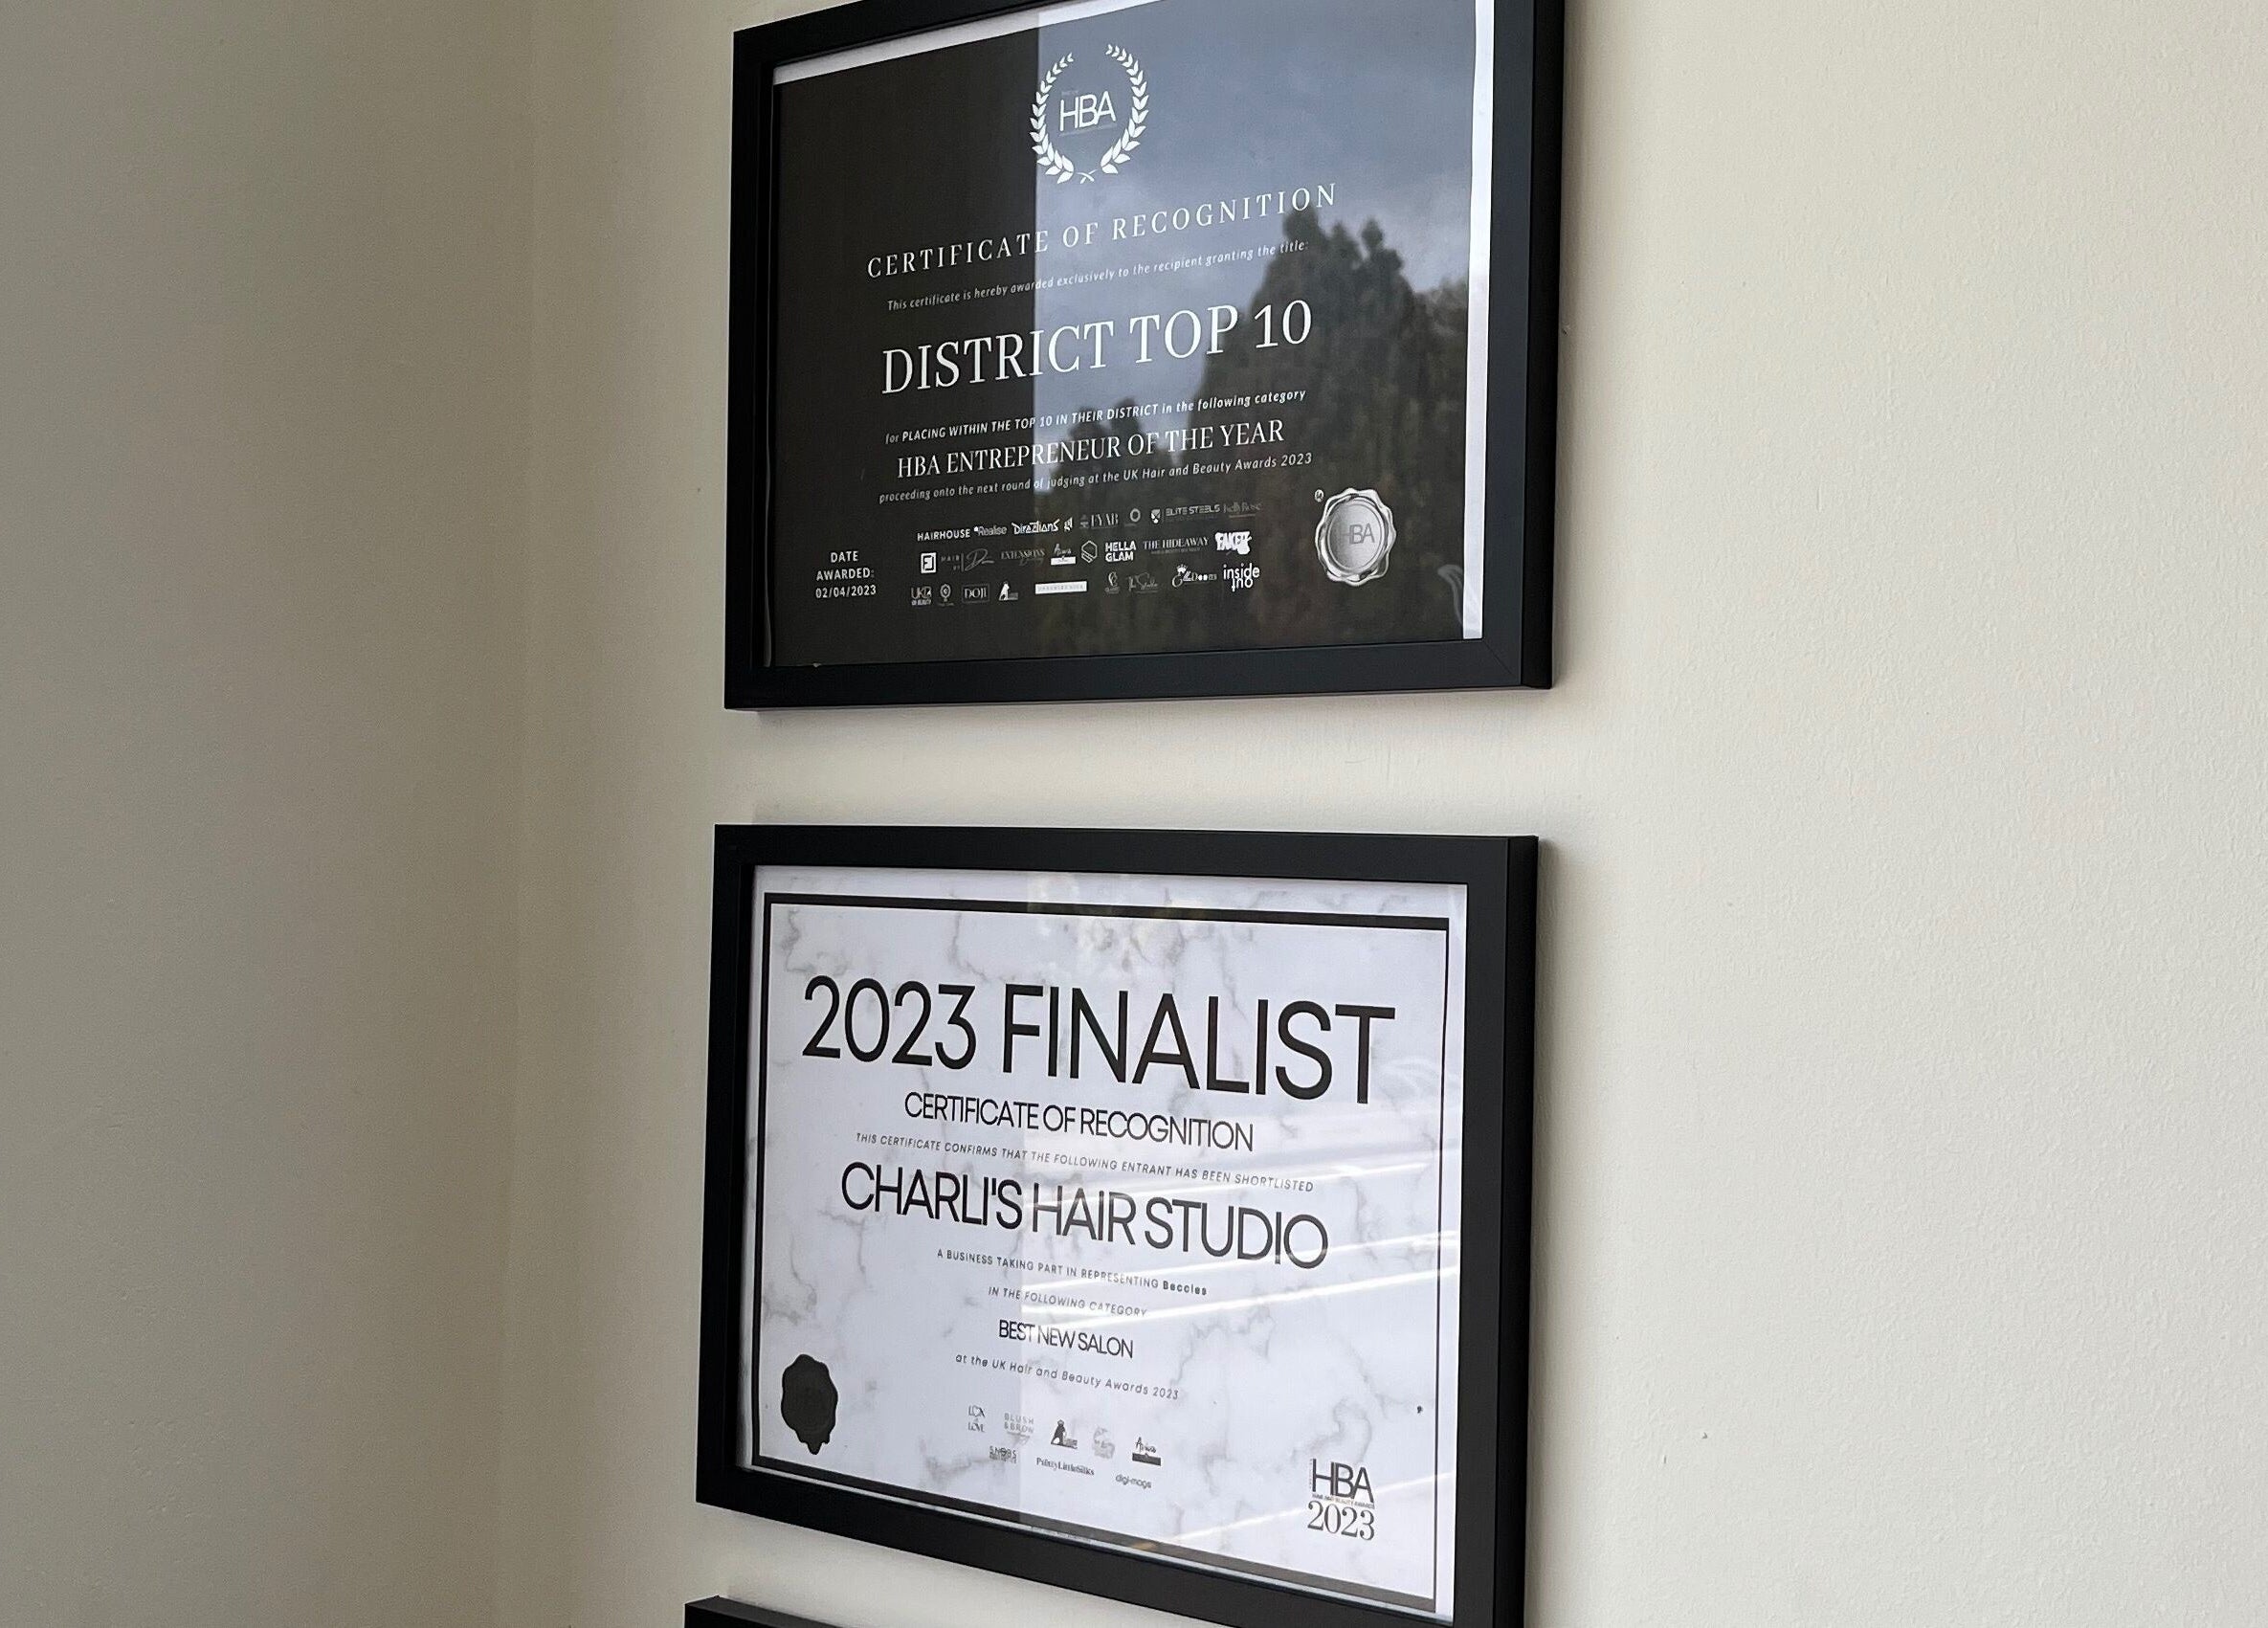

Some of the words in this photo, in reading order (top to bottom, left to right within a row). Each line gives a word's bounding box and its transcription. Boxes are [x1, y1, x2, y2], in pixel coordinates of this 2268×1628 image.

[1059, 90, 1117, 132] HBA
[867, 230, 1049, 279] CERTIFICATE
[1062, 222, 1100, 248] OF
[1111, 183, 1336, 240] RECOGNITION
[887, 300, 907, 311] This
[909, 291, 961, 308] certificate
[963, 288, 972, 301] is
[974, 284, 1009, 300] hereby
[1010, 277, 1055, 294] awarded
[1056, 266, 1116, 286] exclusively
[1118, 267, 1130, 278] to
[1133, 263, 1151, 275] the
[1153, 256, 1203, 274] recipient
[1205, 249, 1254, 267] granting
[1257, 245, 1277, 256] the
[881, 321, 1114, 394] DISTRICT
[1129, 304, 1239, 364] TOP
[1254, 300, 1312, 349] 10
[885, 433, 900, 445] for
[901, 427, 946, 442] PLACING
[948, 422, 988, 437] WITHIN
[990, 419, 1012, 433] THE
[1014, 416, 1036, 430] TOP
[1039, 415, 1053, 428] 10
[1056, 413, 1068, 425] IN
[1072, 410, 1104, 424] THEIR
[1106, 403, 1159, 421] DISTRICT
[1162, 402, 1173, 414] in
[1176, 399, 1195, 413] the
[1197, 393, 1252, 412] following
[1254, 390, 1306, 405] category
[897, 455, 941, 479] HBA
[945, 436, 1122, 475] ENTREPRENEUR
[1127, 432, 1160, 457] OF
[1165, 426, 1214, 453] THE
[1218, 419, 1285, 447] YEAR
[878, 485, 931, 504] proceeding
[933, 486, 956, 498] onto
[958, 483, 974, 496] the
[976, 482, 999, 494] next
[1001, 478, 1032, 492] round
[1045, 474, 1085, 491] judging
[1088, 473, 1100, 484] at
[1102, 470, 1121, 482] the
[1123, 469, 1139, 481] UK
[1142, 466, 1166, 479] Hair
[1168, 463, 1190, 477] and
[1192, 461, 1233, 476] Beauty
[1234, 456, 1278, 472] Awards
[1280, 452, 1313, 467] 2023
[830, 550, 859, 564] DATE
[917, 528, 971, 542] HAIRHOUSE
[1104, 540, 1137, 552] HELLA
[1104, 550, 1135, 563] GLAM
[815, 568, 875, 582] AWARDED:
[815, 584, 877, 599] 02/04/2023
[1223, 562, 1260, 580] inside
[802, 975, 978, 1070] 2023
[1003, 983, 1396, 1104] FINALIST
[904, 1091, 1039, 1130] CERTIFICATE
[1042, 1104, 1078, 1133] OF
[1079, 1108, 1254, 1152] RECOGNITION
[856, 1132, 878, 1145] THIS
[879, 1135, 941, 1151] CERTIFICATE
[944, 1142, 998, 1157] CONFIRMS
[1002, 1148, 1028, 1161] THAT
[1031, 1150, 1051, 1163] THE
[1054, 1153, 1118, 1171] FOLLOWING
[1121, 1161, 1172, 1177] ENTRANT
[1175, 1168, 1198, 1179] HAS
[1202, 1170, 1232, 1184] BEEN
[1234, 1173, 1315, 1193] SHORTLISTED
[841, 1161, 1024, 1230] CHARLI'S
[1032, 1182, 1136, 1246] HAIR
[1144, 1196, 1329, 1270] STUDIO
[937, 1248, 945, 1259] A
[946, 1249, 993, 1265] BUSINESS
[997, 1256, 1034, 1272] TAKING
[1037, 1261, 1064, 1276] PART
[1066, 1266, 1078, 1278] IN
[1080, 1268, 1160, 1289] REPRESENTING
[1162, 1280, 1208, 1296] Beccles
[988, 1286, 999, 1297] IN
[1003, 1287, 1022, 1300] THE
[1024, 1291, 1086, 1309] FOLLOWING
[1089, 1301, 1148, 1318] CATEGORY
[999, 1319, 1035, 1341] BEST
[1037, 1325, 1077, 1349] NEW
[1078, 1332, 1134, 1359] SALON
[955, 1352, 967, 1365] at
[970, 1354, 989, 1368] the
[991, 1358, 1007, 1371] UK
[1010, 1361, 1033, 1375] Hair
[1035, 1365, 1058, 1380] and
[1061, 1371, 1102, 1389] Beauty
[1104, 1377, 1148, 1396] Awards
[1152, 1386, 1179, 1400] 2023
[1312, 1458, 1375, 1504] HBA
[1307, 1500, 1375, 1541] 2023
